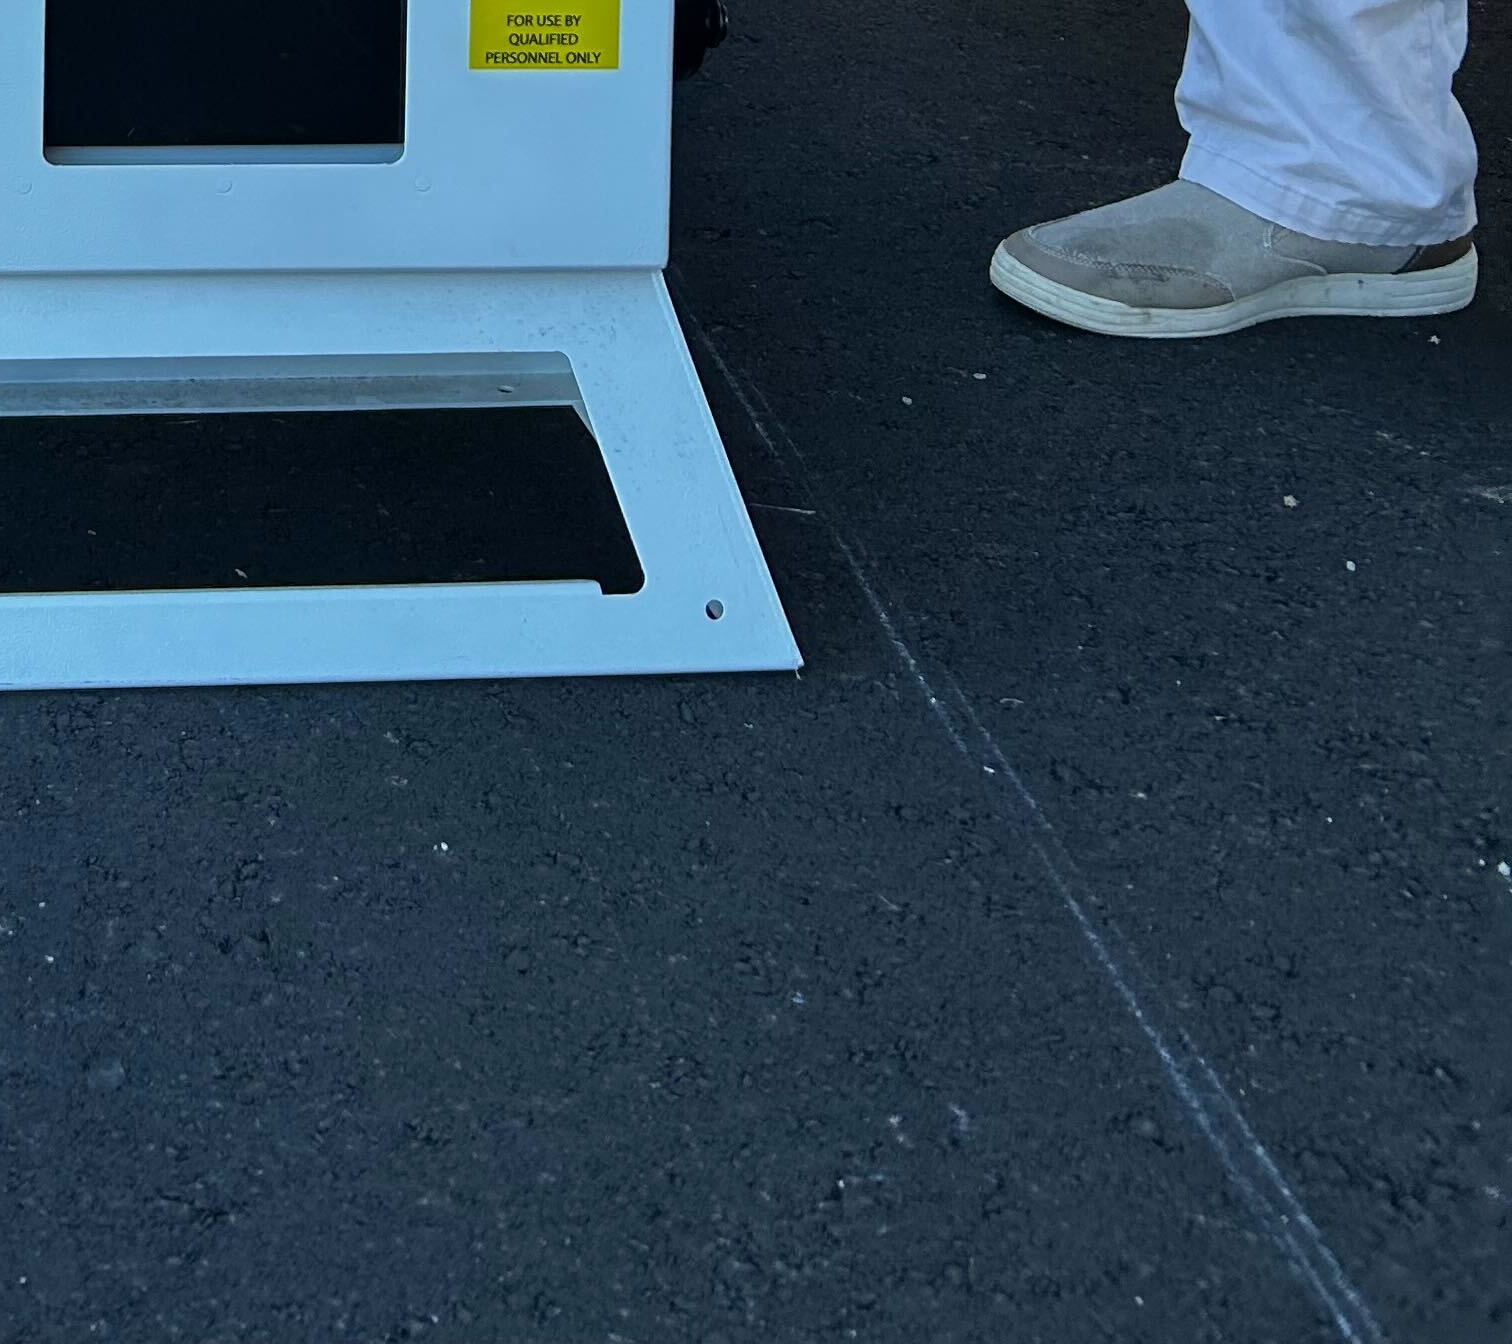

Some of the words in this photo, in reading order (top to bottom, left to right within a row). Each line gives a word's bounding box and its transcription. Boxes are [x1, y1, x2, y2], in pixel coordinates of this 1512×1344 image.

[506, 14, 533, 27] FOR
[536, 14, 561, 27] USE
[564, 14, 582, 27] BY
[508, 33, 579, 46] QUALIFIED
[485, 51, 563, 64] PERSONNEL
[566, 51, 601, 64] ONLY
